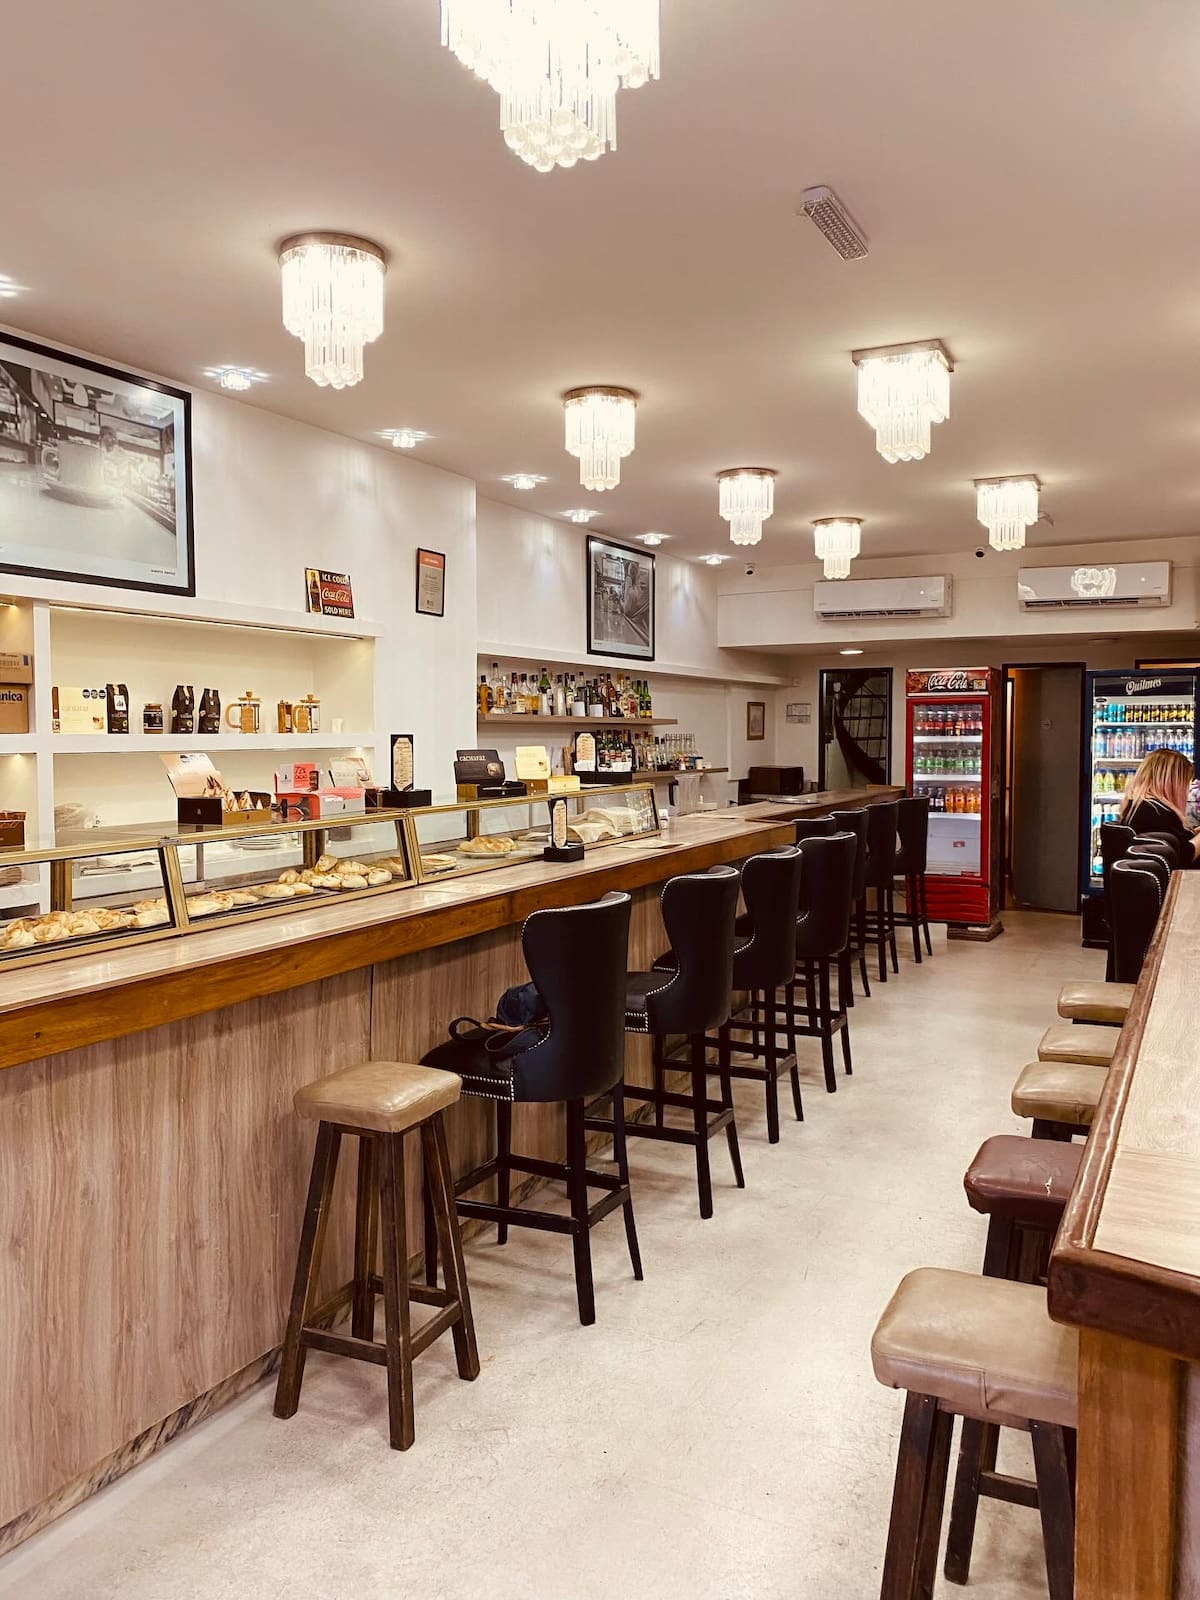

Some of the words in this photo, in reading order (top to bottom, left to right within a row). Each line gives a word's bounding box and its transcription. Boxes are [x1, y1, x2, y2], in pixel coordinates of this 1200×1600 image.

[321, 573, 331, 581] ICE
[324, 605, 338, 614] SOLD
[1125, 679, 1162, 695] Quilmes
